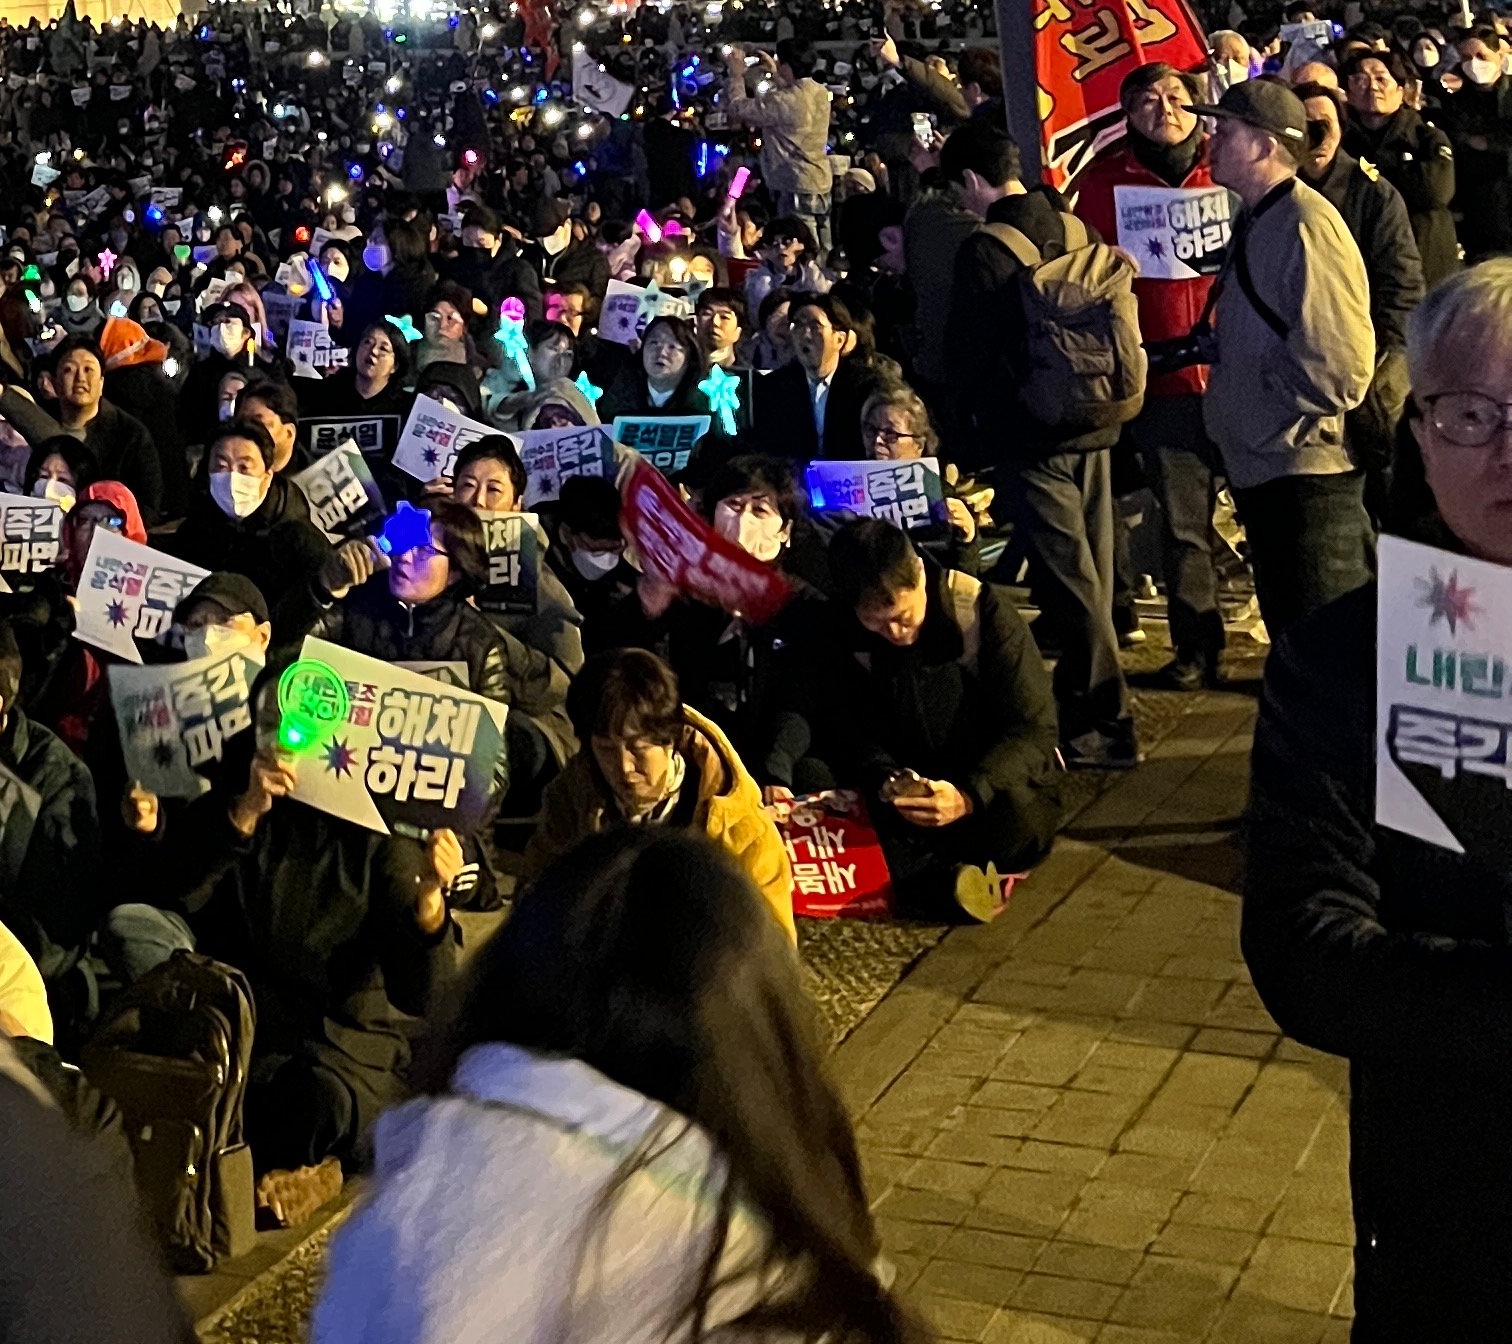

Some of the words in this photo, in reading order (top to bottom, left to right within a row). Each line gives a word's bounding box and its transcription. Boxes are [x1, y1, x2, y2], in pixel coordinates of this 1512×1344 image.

[1169, 193, 1231, 229] 해체
[1172, 221, 1232, 259] 하라
[557, 428, 603, 464] 즉각
[868, 463, 926, 502] 즉각
[5, 506, 64, 541] 즉각
[317, 478, 368, 531] 파면
[482, 517, 522, 552] 체
[0, 541, 60, 573] 파면
[172, 654, 249, 718] 즉각
[1405, 643, 1512, 699] 내란
[378, 688, 482, 755] 해체
[366, 745, 466, 809] 하라
